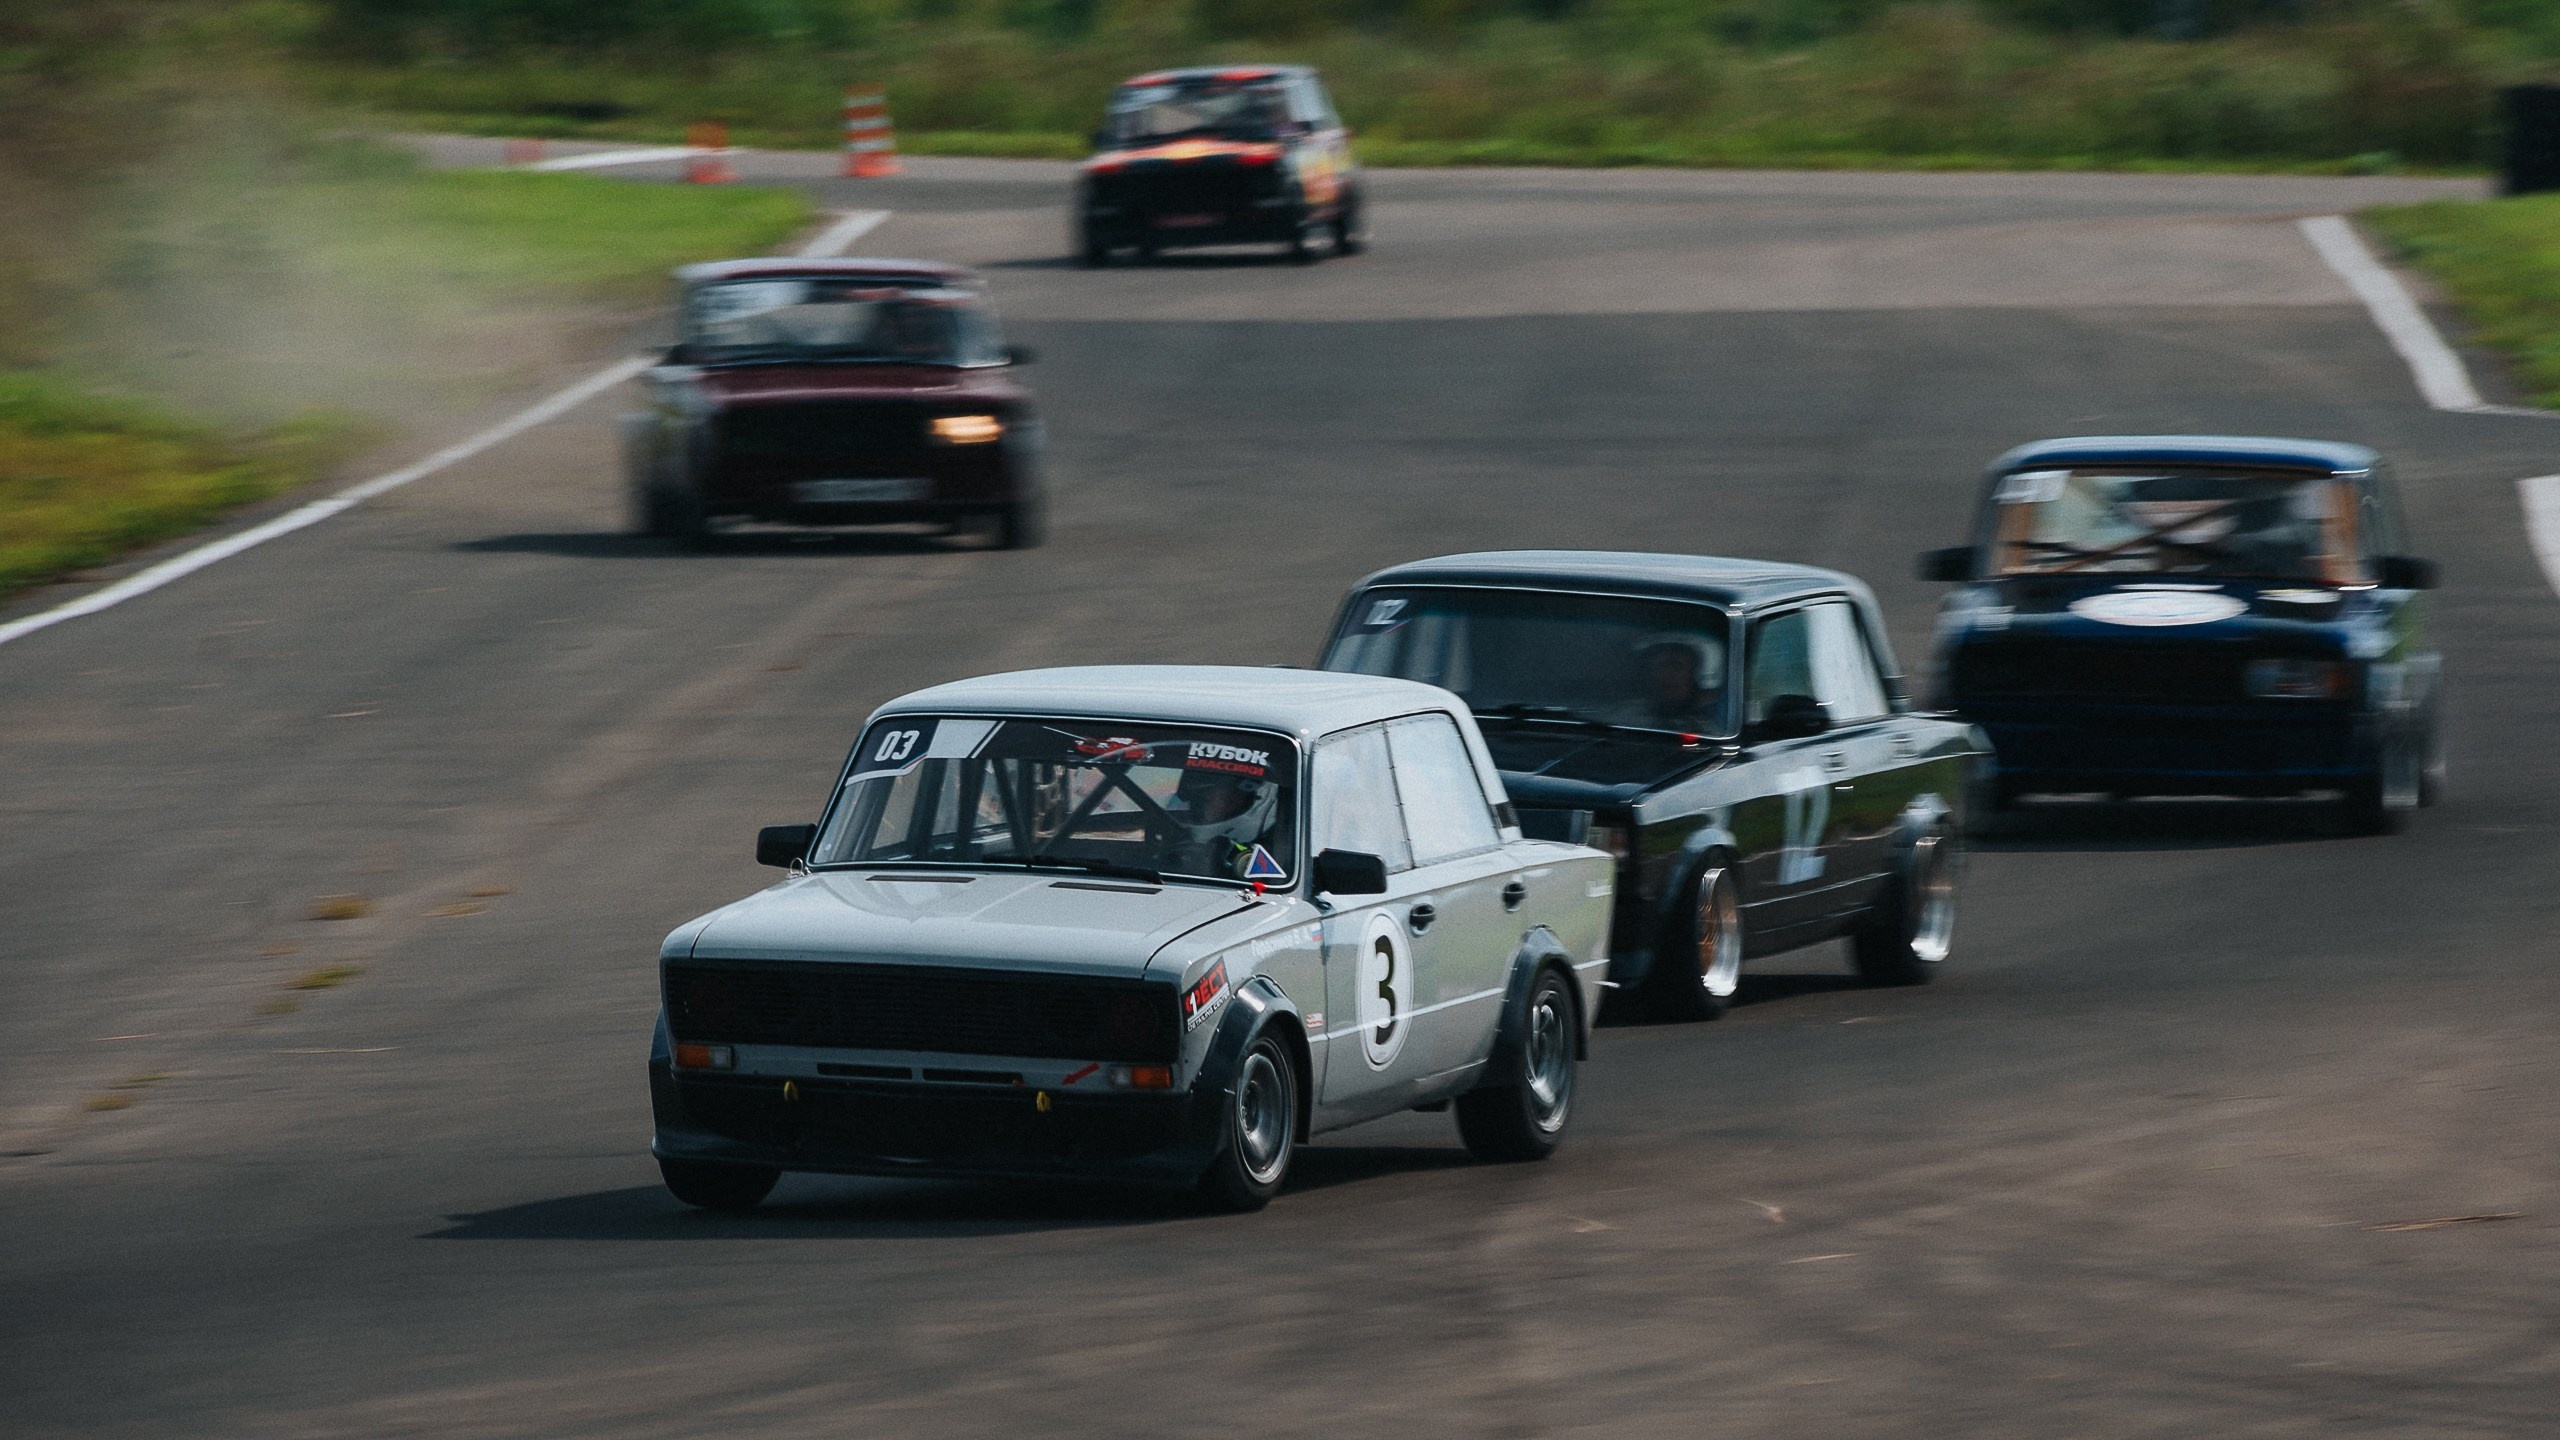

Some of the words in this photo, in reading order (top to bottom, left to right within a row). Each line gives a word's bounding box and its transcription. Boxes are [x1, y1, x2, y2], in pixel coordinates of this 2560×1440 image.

[1363, 599, 1409, 625] 12
[874, 730, 920, 762] 03
[1188, 742, 1270, 766] КУБОК
[1184, 759, 1265, 776] КЛАССИКИ
[1777, 765, 1832, 885] 12
[1375, 934, 1396, 1046] 3
